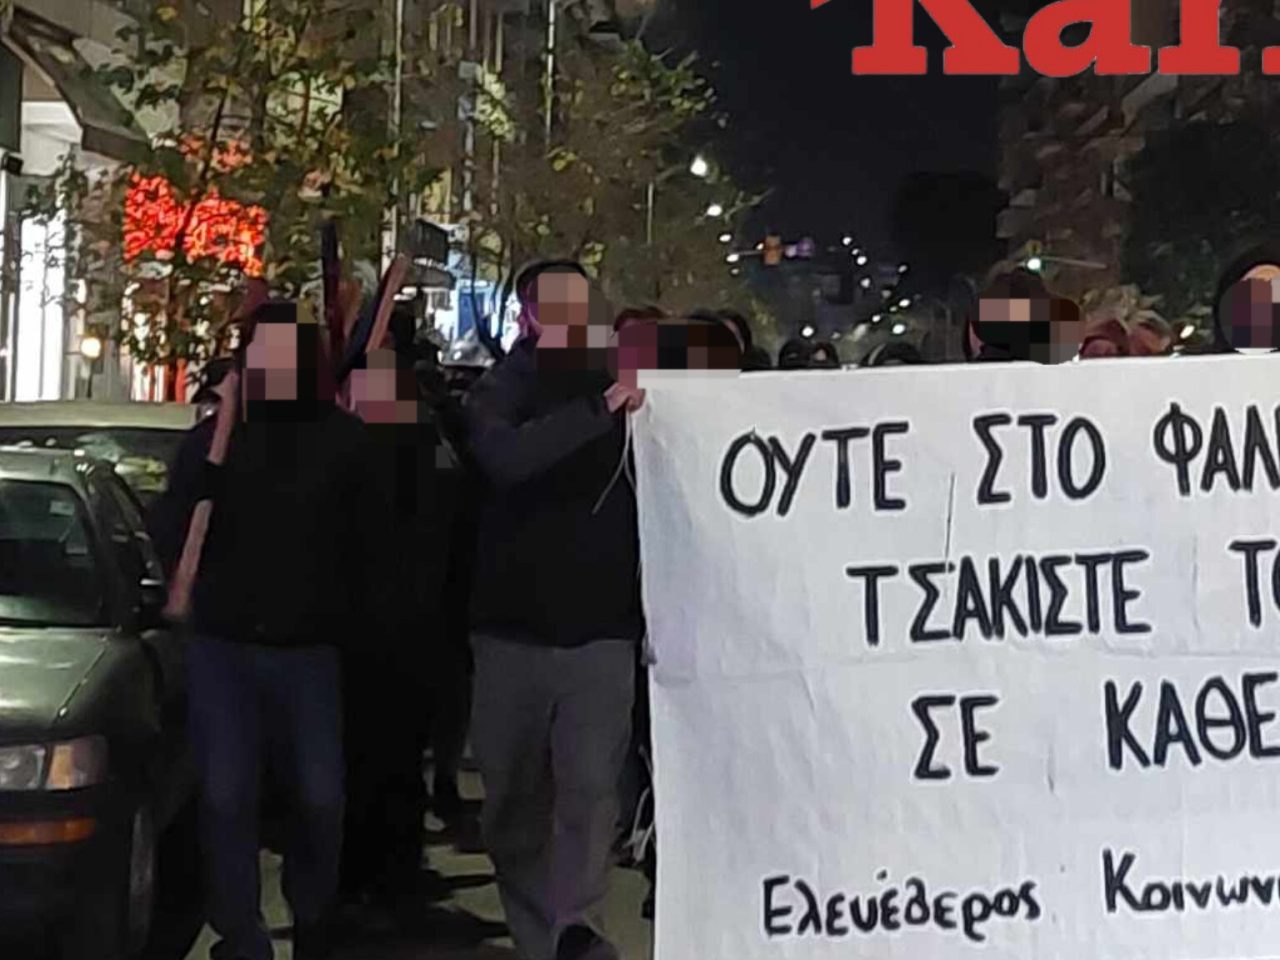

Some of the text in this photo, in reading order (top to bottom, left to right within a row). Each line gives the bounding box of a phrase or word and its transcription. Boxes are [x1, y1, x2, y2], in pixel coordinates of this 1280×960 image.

[719, 420, 910, 518] ΟΥΤΕ
[972, 413, 1107, 505] ΣΤΟ
[845, 549, 1152, 647] ΤΣΑΚΙΣΤΕ
[910, 694, 1000, 781] ΣΕ
